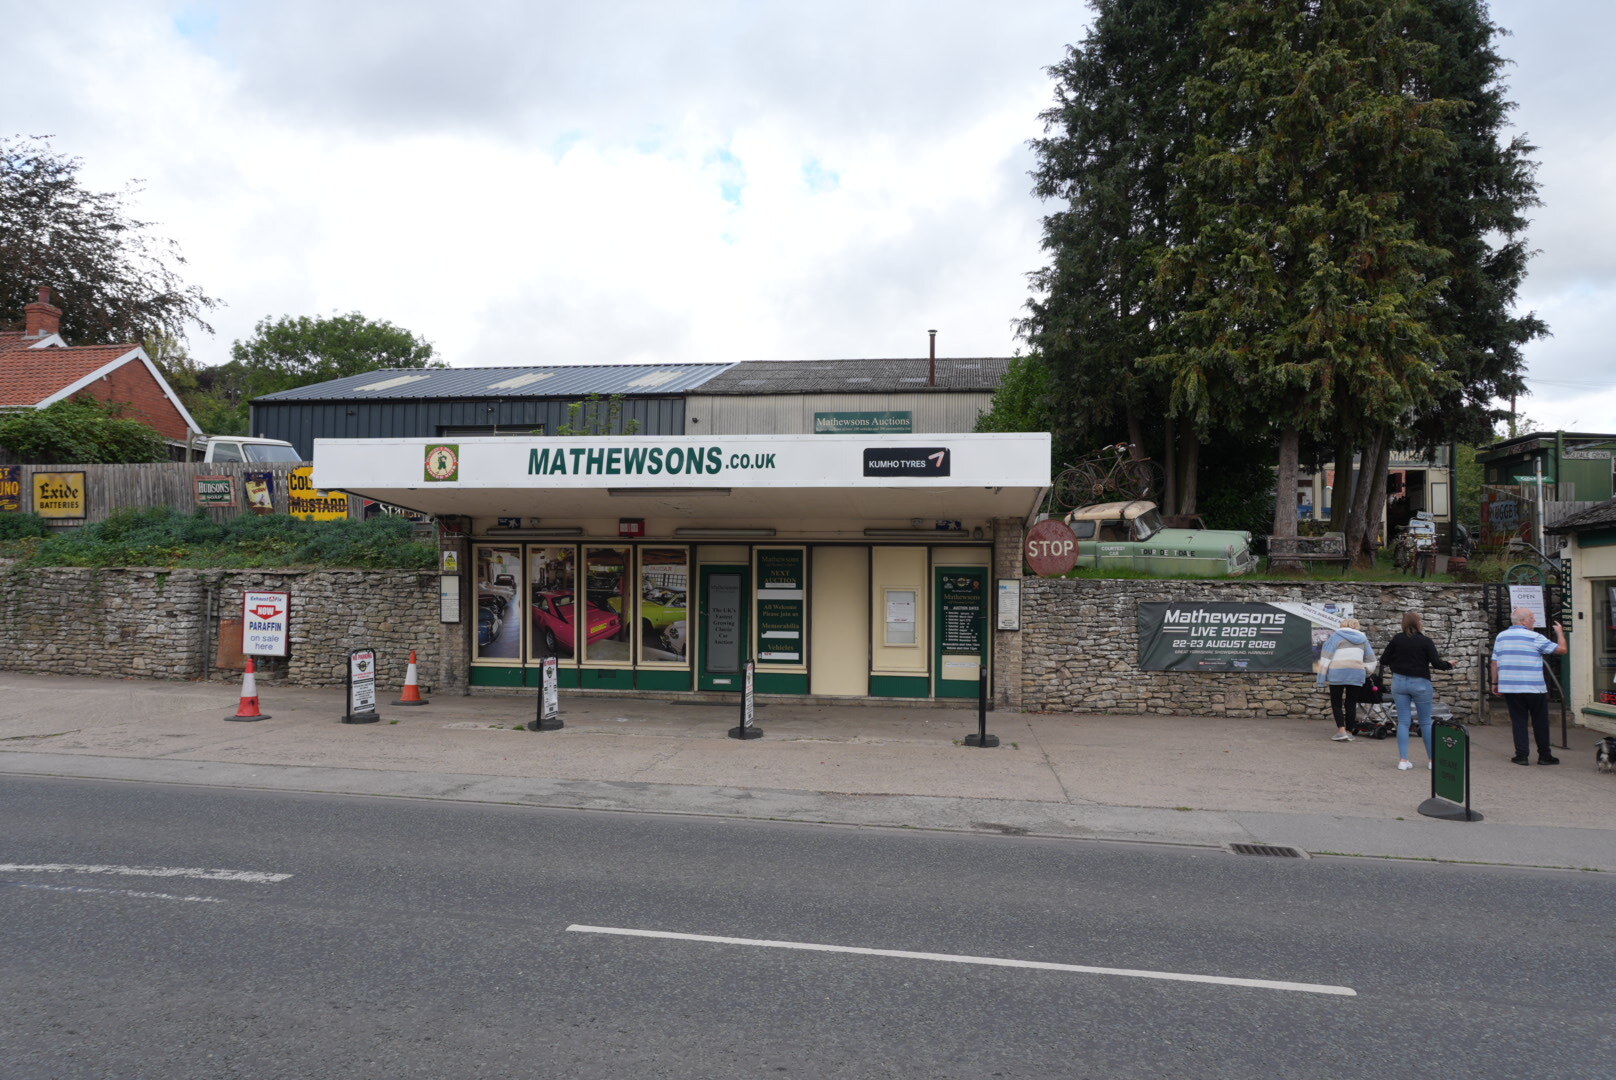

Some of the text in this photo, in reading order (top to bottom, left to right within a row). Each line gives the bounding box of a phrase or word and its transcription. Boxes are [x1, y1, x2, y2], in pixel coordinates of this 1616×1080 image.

[816, 417, 910, 426] Mathewsons Auctions
[528, 446, 722, 475] MATHEWSONS
[869, 460, 926, 468] KUMHO TYRES
[39, 482, 79, 499] Exide
[40, 501, 79, 509] BATTERIES
[291, 498, 346, 513] MUSTARD
[1028, 540, 1074, 557] STOP
[257, 607, 274, 615] NOW
[1164, 610, 1286, 624] Mathewsons
[249, 621, 282, 631] PARAFFIN
[1191, 627, 1257, 637] LIVE 2026
[1173, 640, 1276, 649] 22-23 AUGUST 2026
